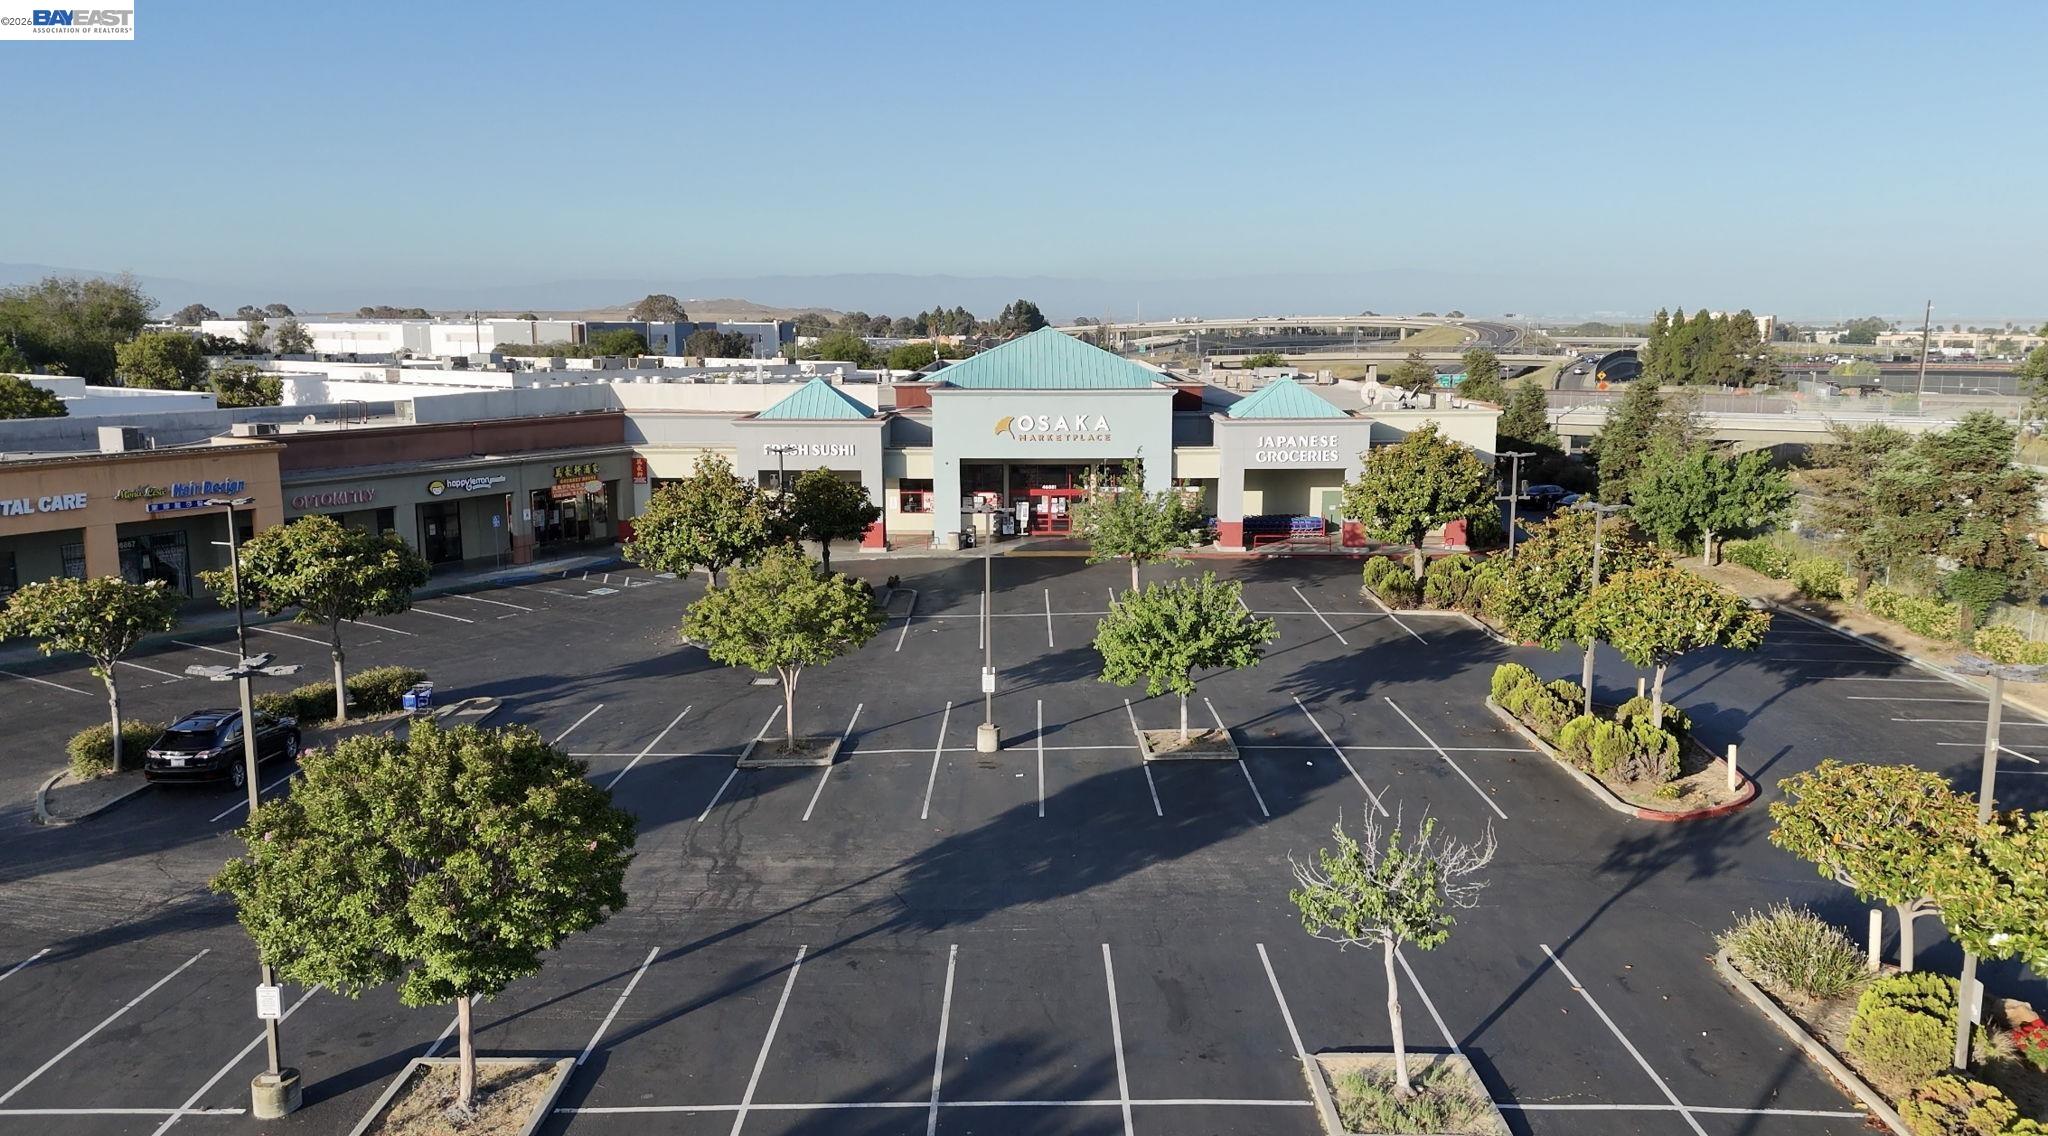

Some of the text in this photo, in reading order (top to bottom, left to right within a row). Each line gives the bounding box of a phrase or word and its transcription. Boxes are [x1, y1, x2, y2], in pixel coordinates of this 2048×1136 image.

[1017, 415, 1111, 432] OSAKA
[1019, 434, 1112, 442] MARKETPLACE
[1256, 435, 1339, 448] JAPANESE
[764, 444, 856, 456] FRESH SUSHI
[1255, 450, 1340, 463] GROCERIES
[171, 481, 201, 498] Hair
[202, 477, 245, 496] Design
[38, 493, 88, 513] CARE
[292, 487, 376, 510] OPTOMETRY
